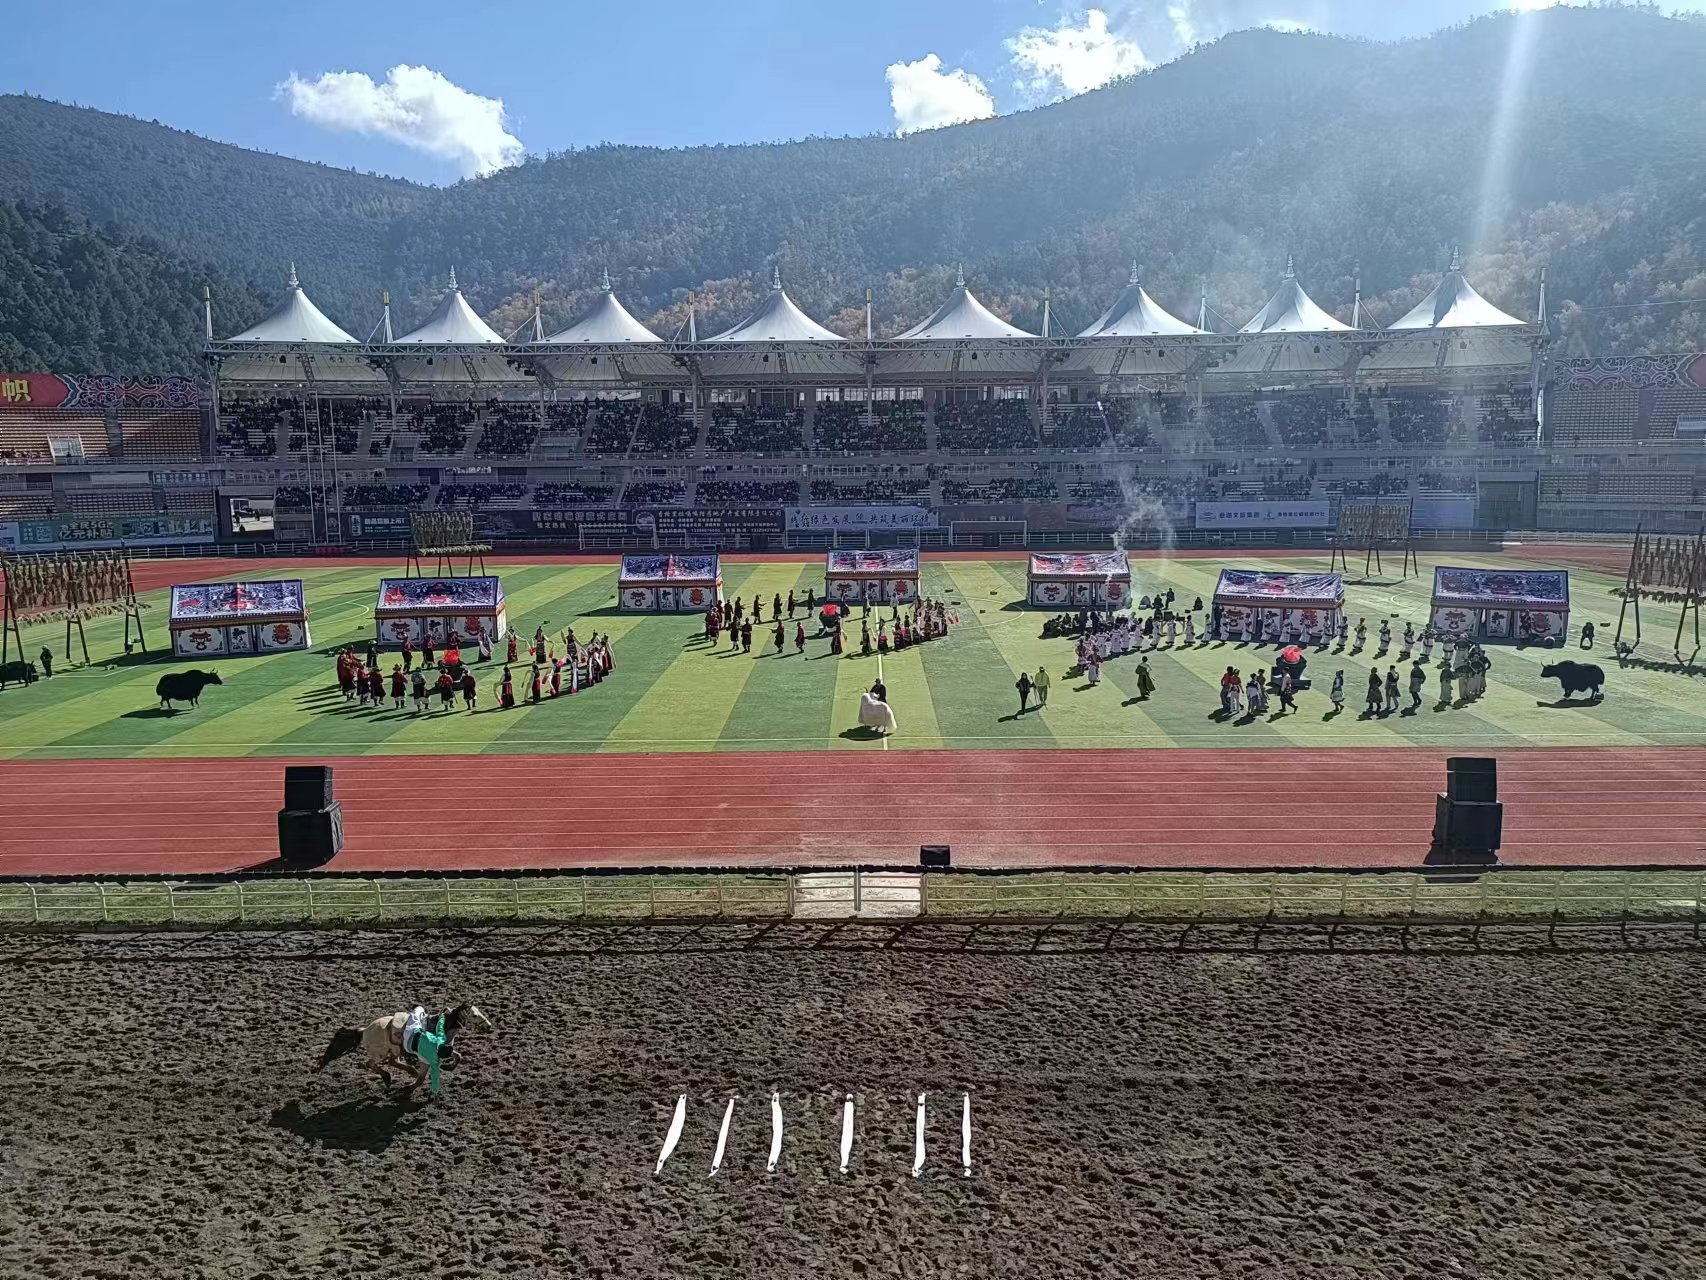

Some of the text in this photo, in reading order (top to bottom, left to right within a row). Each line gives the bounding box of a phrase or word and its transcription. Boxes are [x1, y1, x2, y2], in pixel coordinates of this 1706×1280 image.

[2, 378, 32, 402] 帜
[58, 529, 113, 540] 亿元补贴
